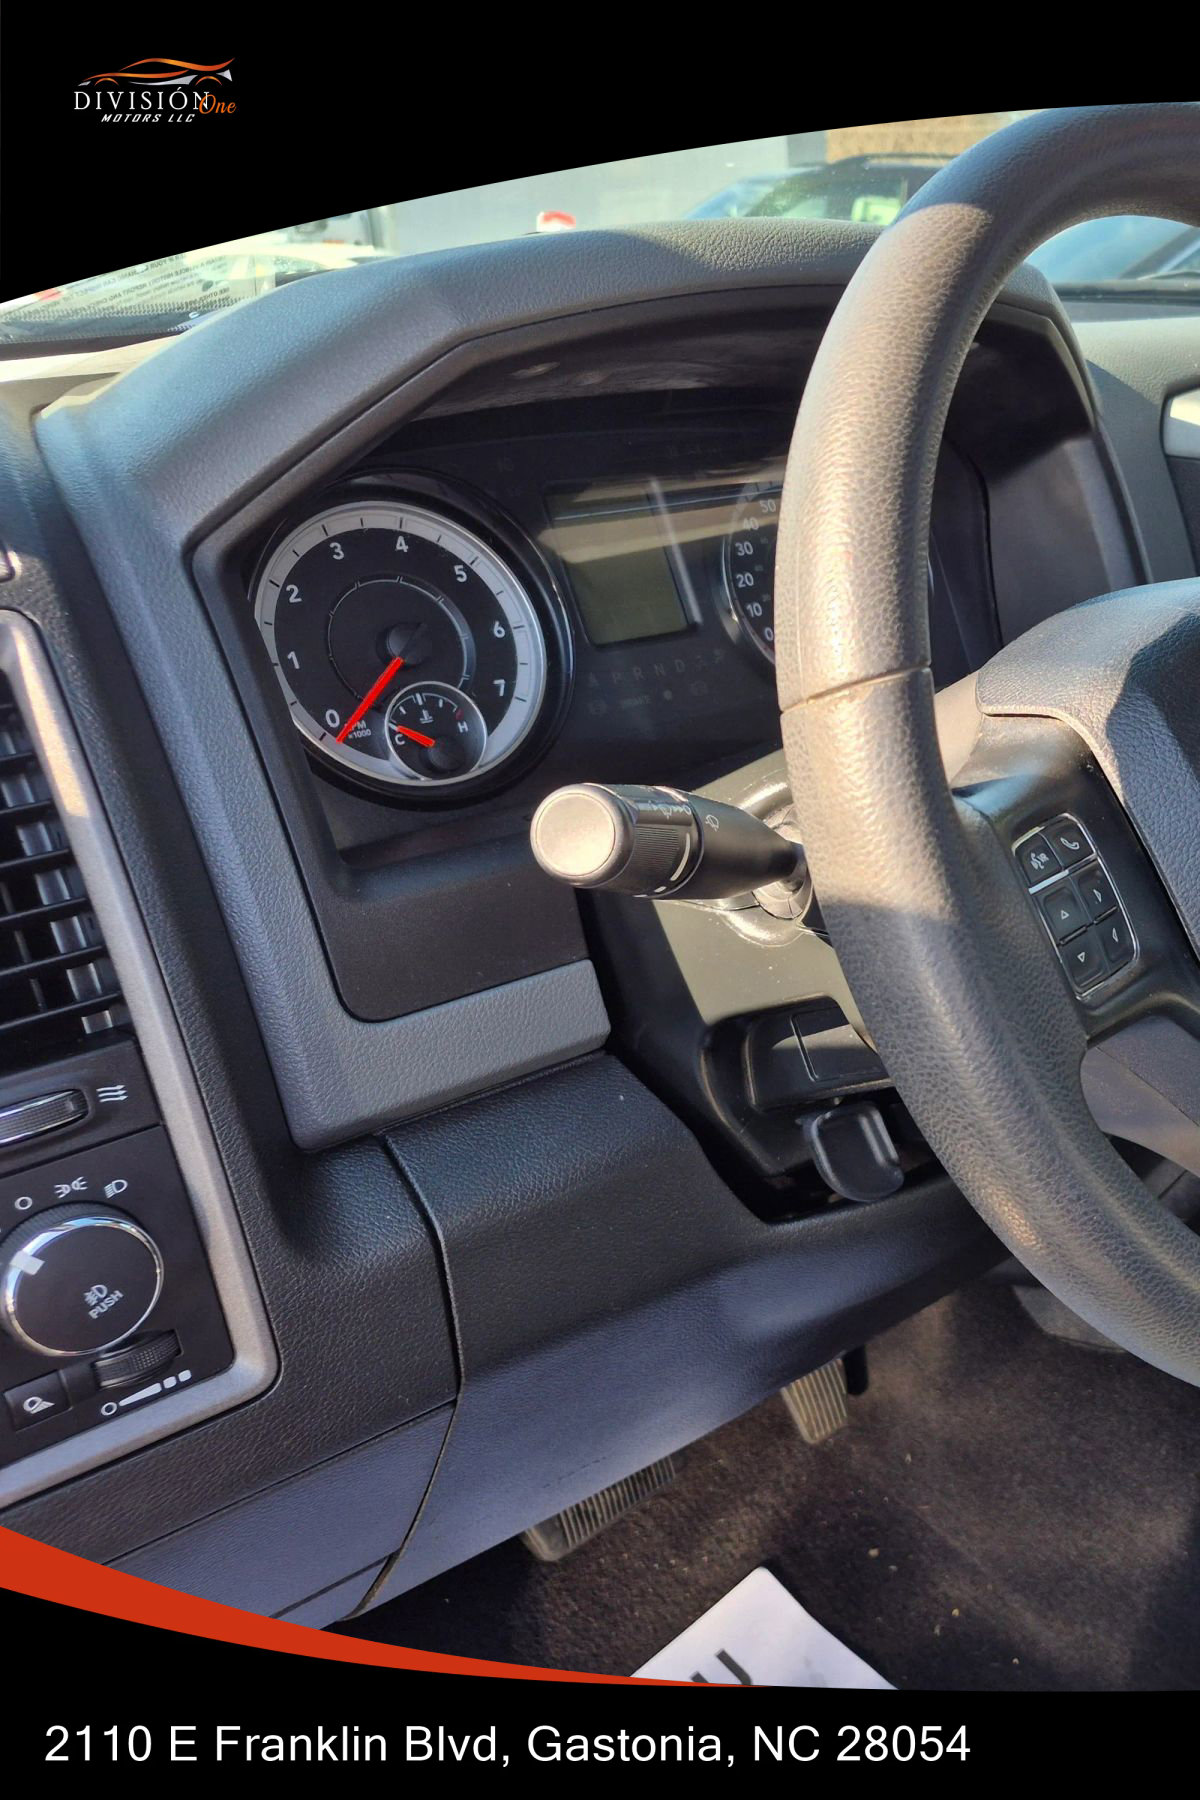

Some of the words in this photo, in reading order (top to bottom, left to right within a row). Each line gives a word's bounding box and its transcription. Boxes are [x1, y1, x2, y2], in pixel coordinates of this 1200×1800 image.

[759, 499, 776, 513] 50
[743, 516, 759, 531] 40
[329, 541, 345, 561] 3
[396, 535, 409, 553] 4
[735, 541, 754, 556] 30
[454, 564, 468, 583] 5
[736, 572, 754, 588] 20
[286, 584, 302, 603] 2
[746, 602, 762, 617] 10
[493, 620, 507, 638] 6
[763, 626, 774, 641] 0
[287, 651, 301, 669] 1
[493, 679, 506, 696] 7
[325, 709, 340, 728] 0
[457, 720, 469, 733] H
[394, 733, 406, 746] C
[88, 1289, 124, 1320] PUSH
